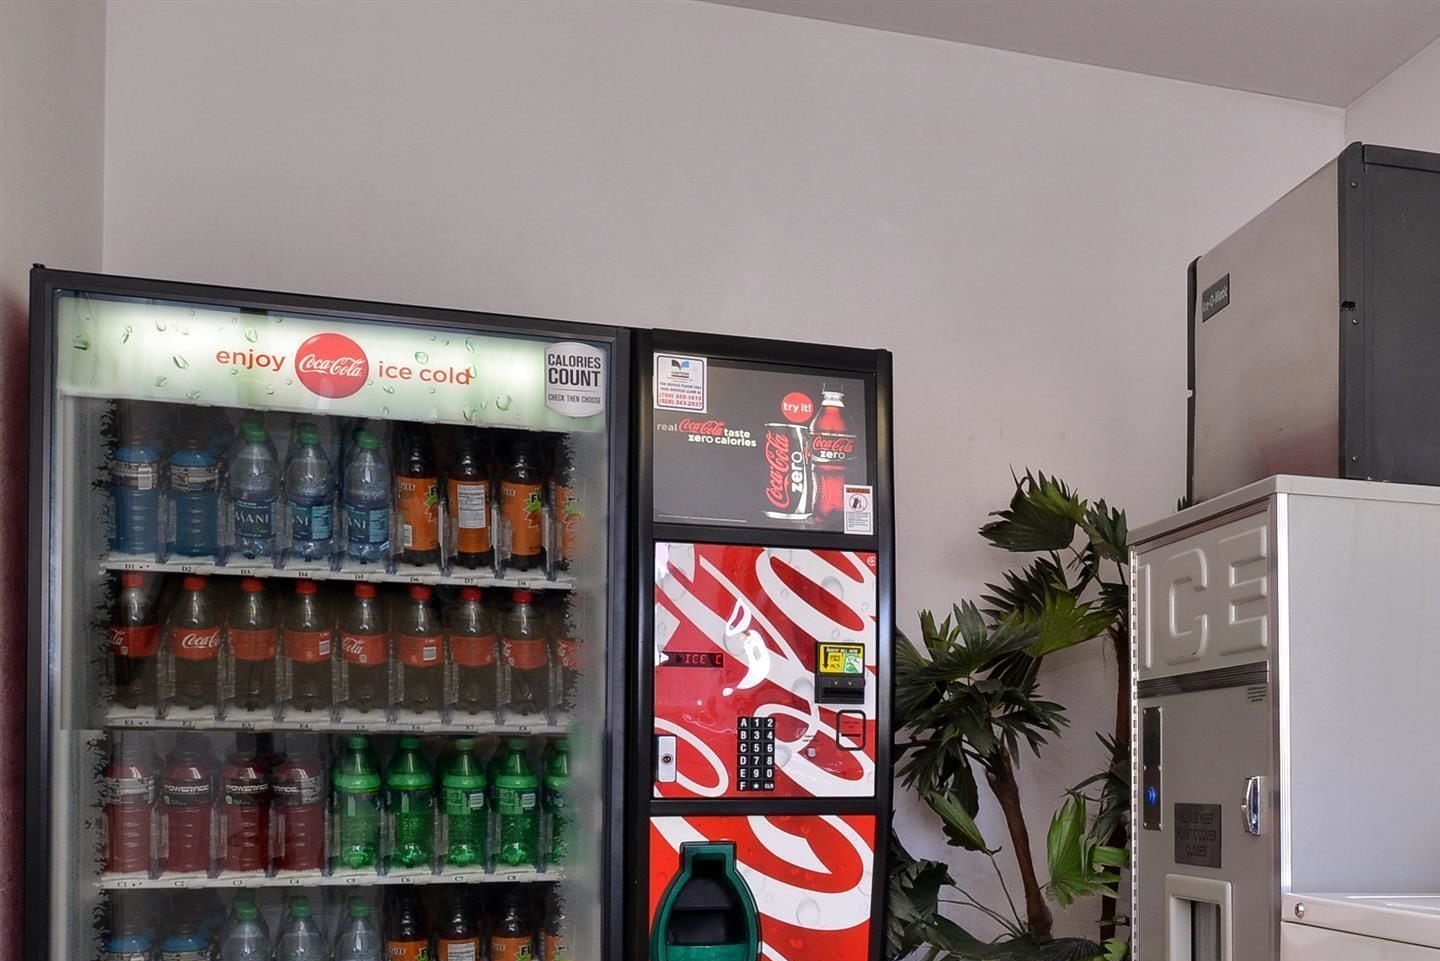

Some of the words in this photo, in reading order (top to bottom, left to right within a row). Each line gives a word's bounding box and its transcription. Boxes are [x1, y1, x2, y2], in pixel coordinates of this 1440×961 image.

[548, 353, 601, 369] CALORIES
[216, 349, 286, 372] enjoy
[299, 353, 365, 378] Coca-Cola
[379, 361, 412, 380] ice
[419, 367, 470, 385] cold
[548, 367, 601, 387] COUNT
[548, 394, 565, 402] CHECK
[567, 395, 580, 403] THEN
[581, 396, 601, 404] CHOOSE
[783, 403, 799, 412] try
[801, 403, 812, 412] it!
[657, 423, 678, 431] real
[678, 418, 726, 436] Coca-Cola
[723, 428, 751, 438] taste
[688, 434, 714, 443] zero
[714, 436, 757, 447] calories
[812, 435, 855, 453] Coca-Cola
[820, 449, 846, 459] zero
[765, 430, 791, 509] Coca-Cola
[791, 451, 803, 493] zero
[1138, 524, 1268, 669] ICE
[685, 654, 706, 664] ICE
[740, 719, 747, 727] A
[754, 719, 760, 727] 1
[767, 719, 773, 727] 2
[740, 731, 747, 739] B
[754, 731, 760, 739] 3
[767, 731, 773, 739] 4
[740, 744, 747, 752] C
[754, 744, 760, 752] 5
[767, 744, 773, 752] 6
[740, 756, 747, 765] D
[754, 756, 760, 765] 7
[767, 756, 773, 765] 8
[740, 769, 747, 777] E
[754, 769, 760, 777] 9
[767, 769, 773, 777] 0
[740, 782, 746, 790] F
